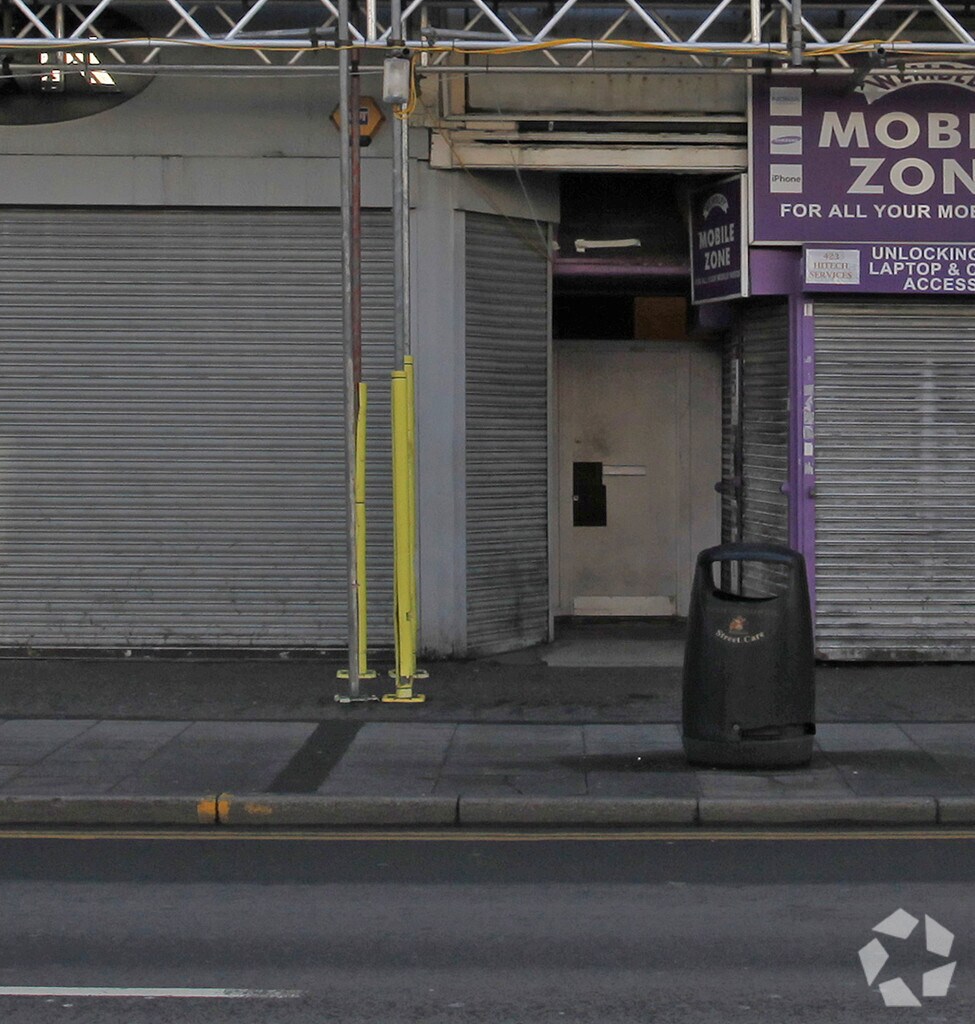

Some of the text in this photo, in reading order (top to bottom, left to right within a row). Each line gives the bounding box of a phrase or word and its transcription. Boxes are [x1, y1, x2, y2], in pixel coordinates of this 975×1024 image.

[771, 174, 801, 183] iPhone
[780, 204, 822, 218] FOR
[828, 204, 867, 218] ALL
[873, 204, 932, 219] YOUR
[699, 223, 735, 250] MOBILE
[704, 247, 731, 271] ZONE
[869, 262, 942, 276] LAPTOP
[948, 262, 960, 276] &
[903, 277, 975, 292] ACCESS
